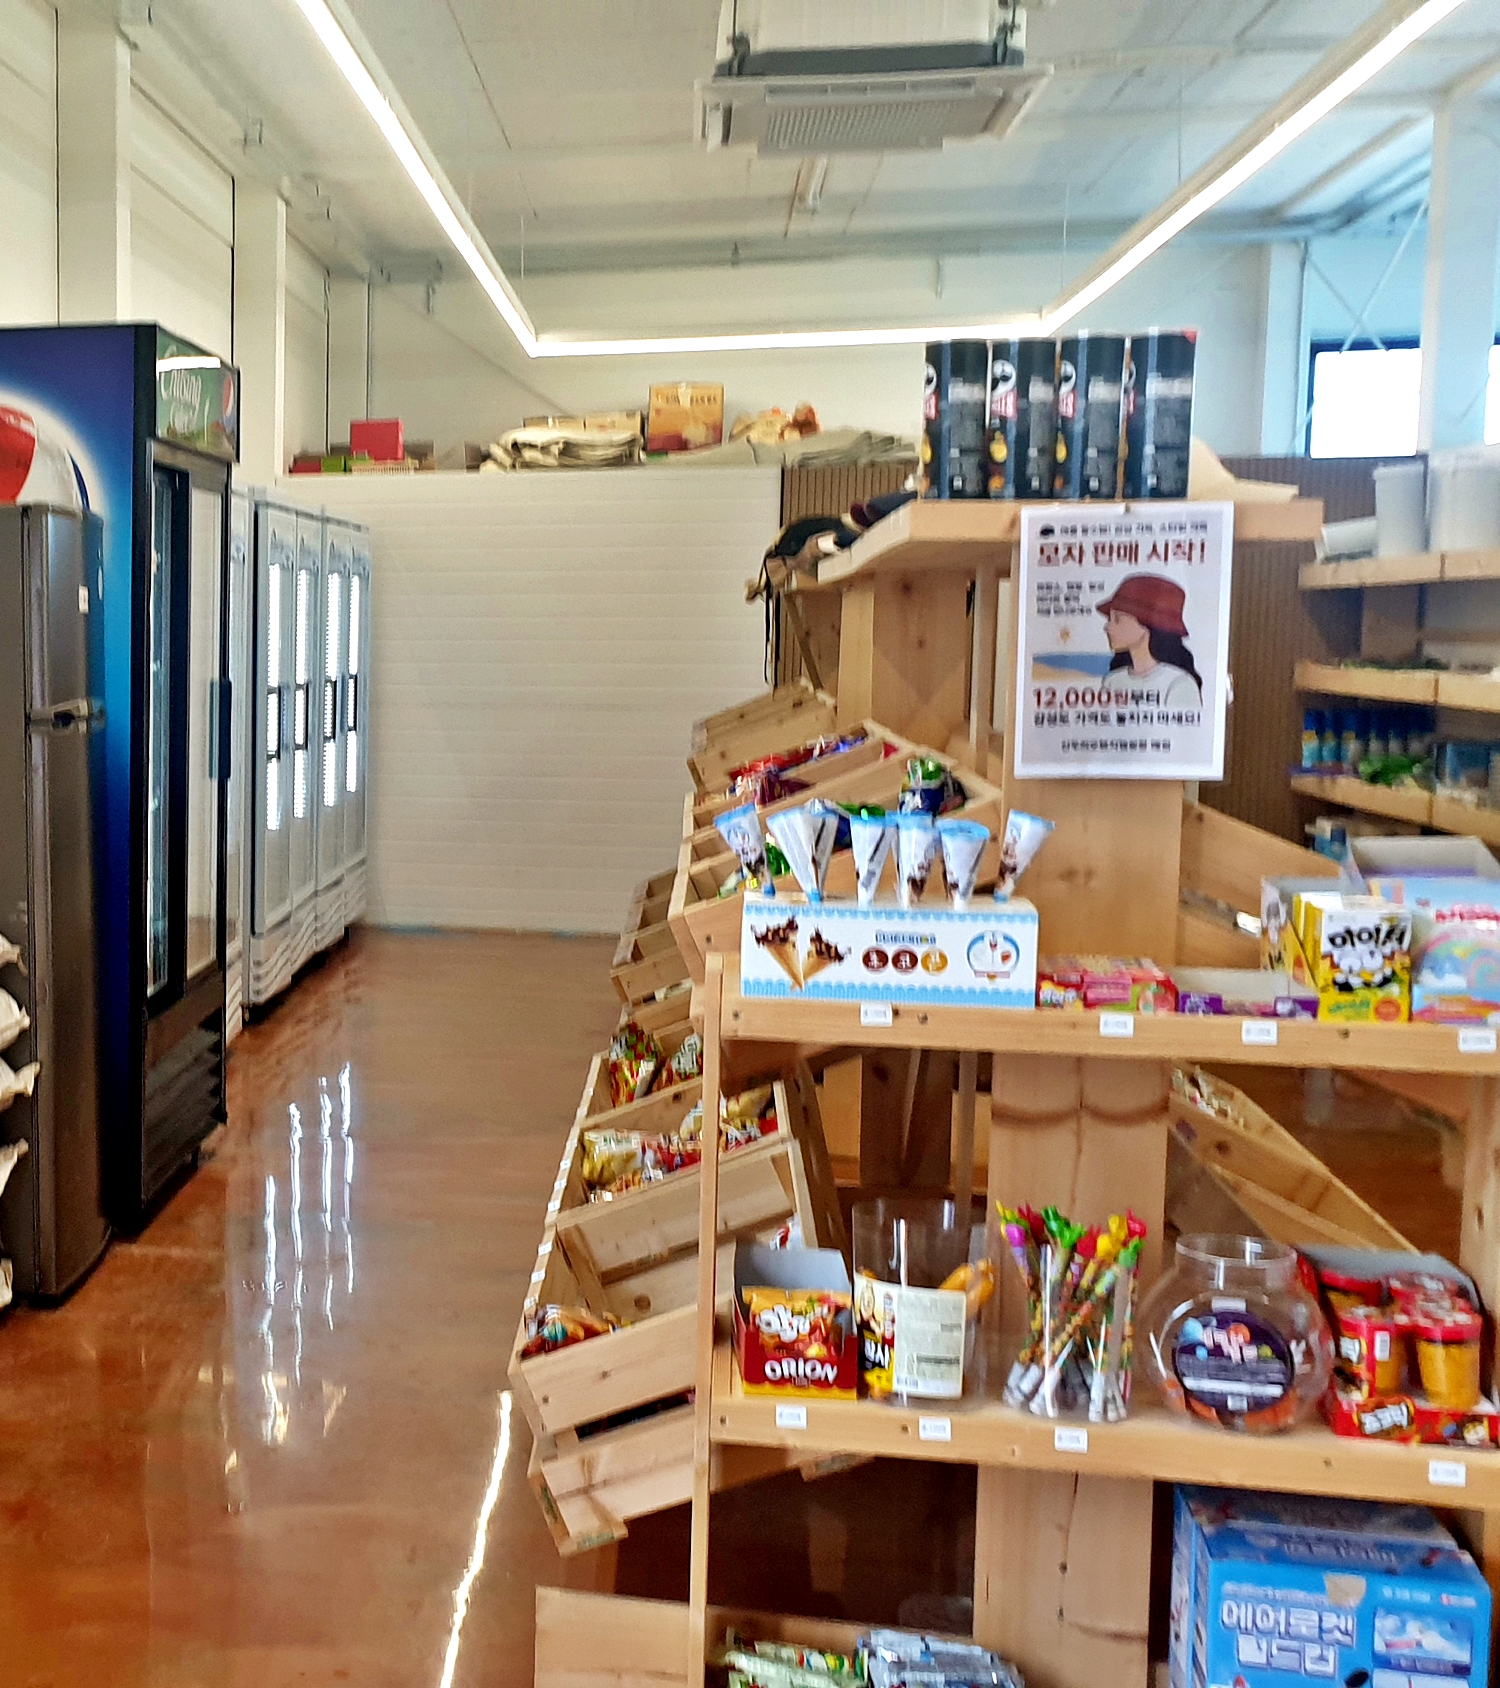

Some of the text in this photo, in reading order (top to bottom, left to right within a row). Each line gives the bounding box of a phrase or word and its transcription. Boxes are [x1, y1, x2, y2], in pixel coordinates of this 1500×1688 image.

[1038, 538, 1205, 567] 모자 판매 시작!
[1033, 686, 1160, 710] 12,000원부터
[765, 1358, 838, 1384] ORION
[1222, 1599, 1356, 1649] 에어로켓
